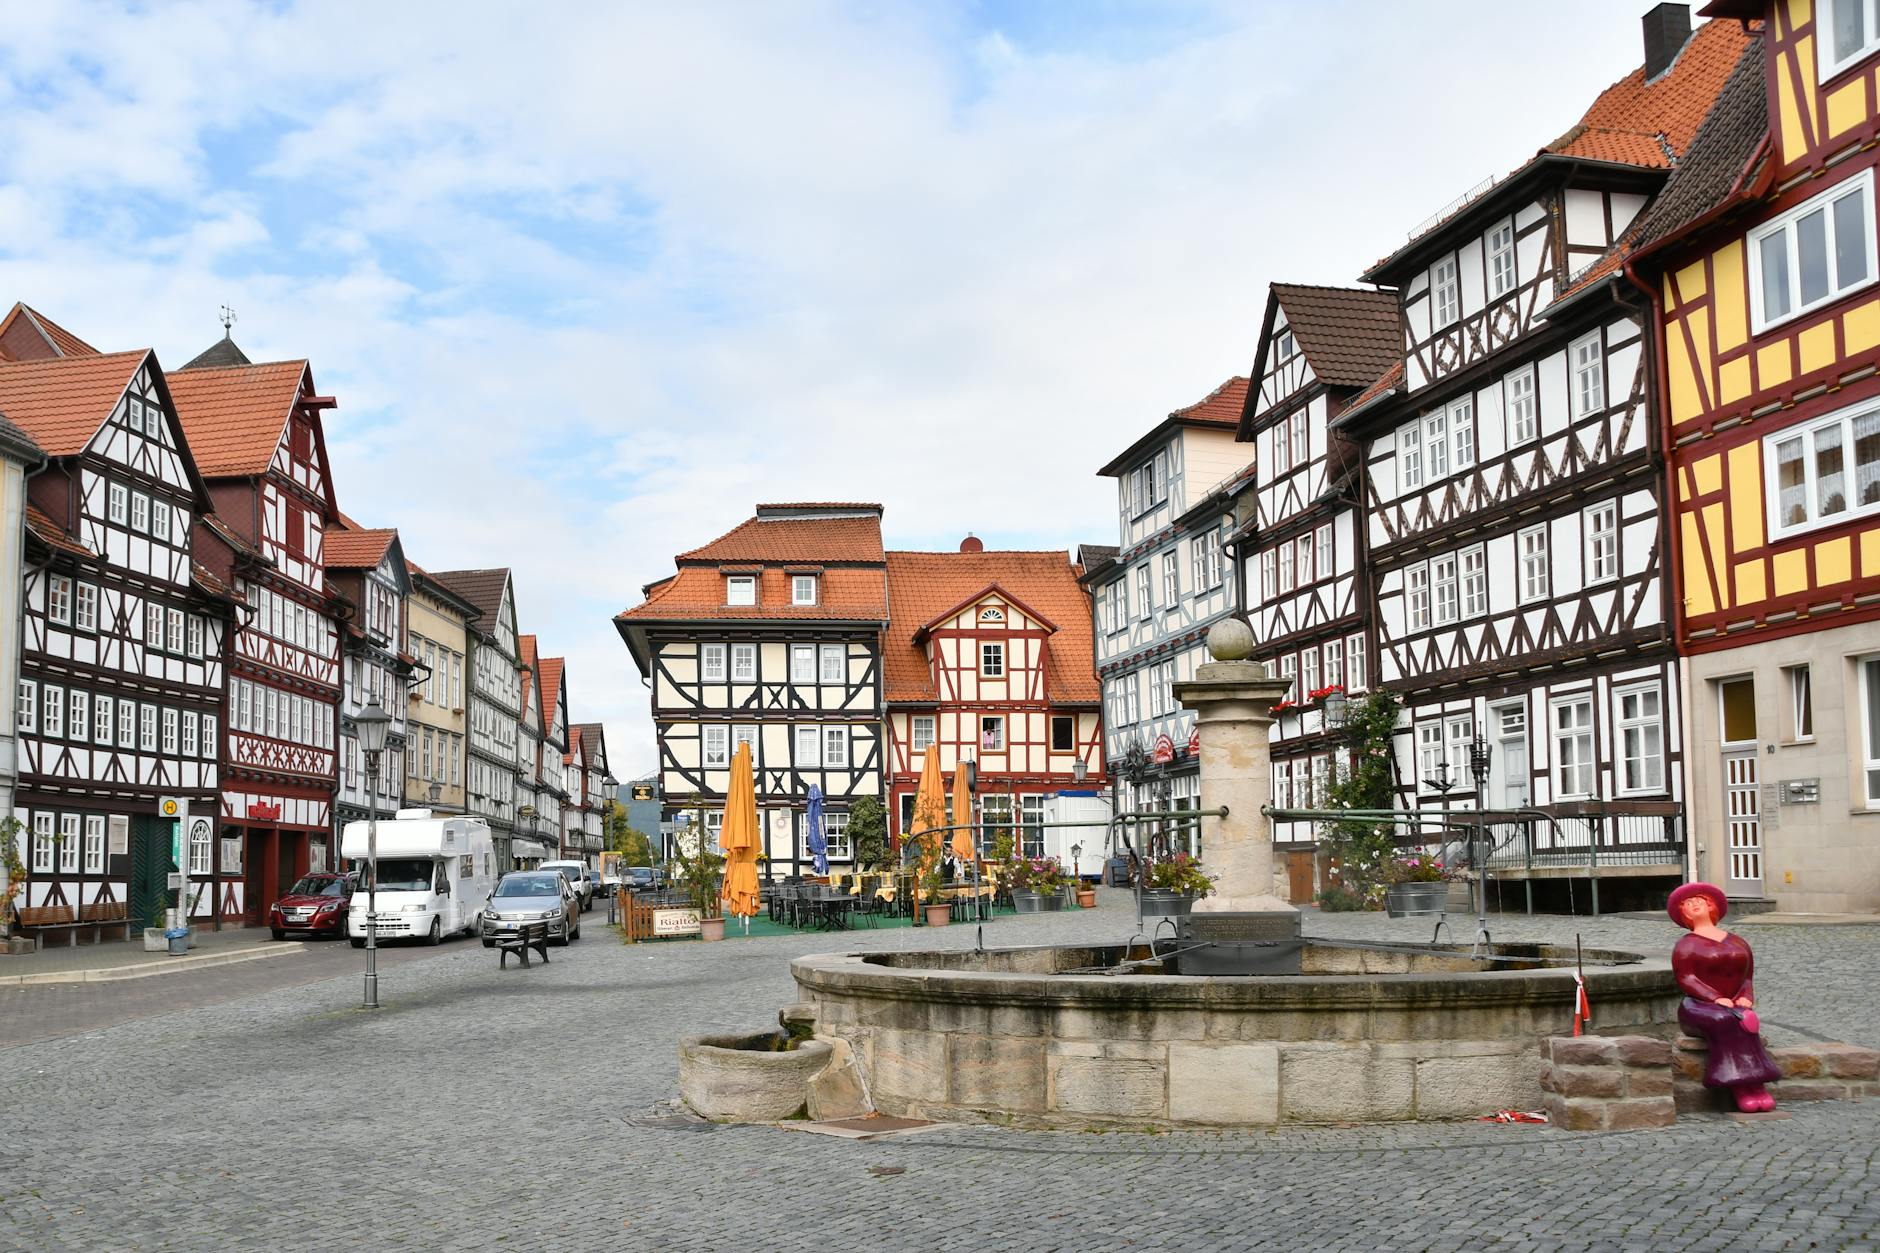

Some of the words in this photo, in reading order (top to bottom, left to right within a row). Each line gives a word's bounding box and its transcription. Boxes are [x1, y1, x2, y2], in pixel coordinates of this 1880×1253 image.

[1766, 744, 1775, 755] 10
[166, 803, 173, 812] H
[660, 917, 696, 926] Rialto
